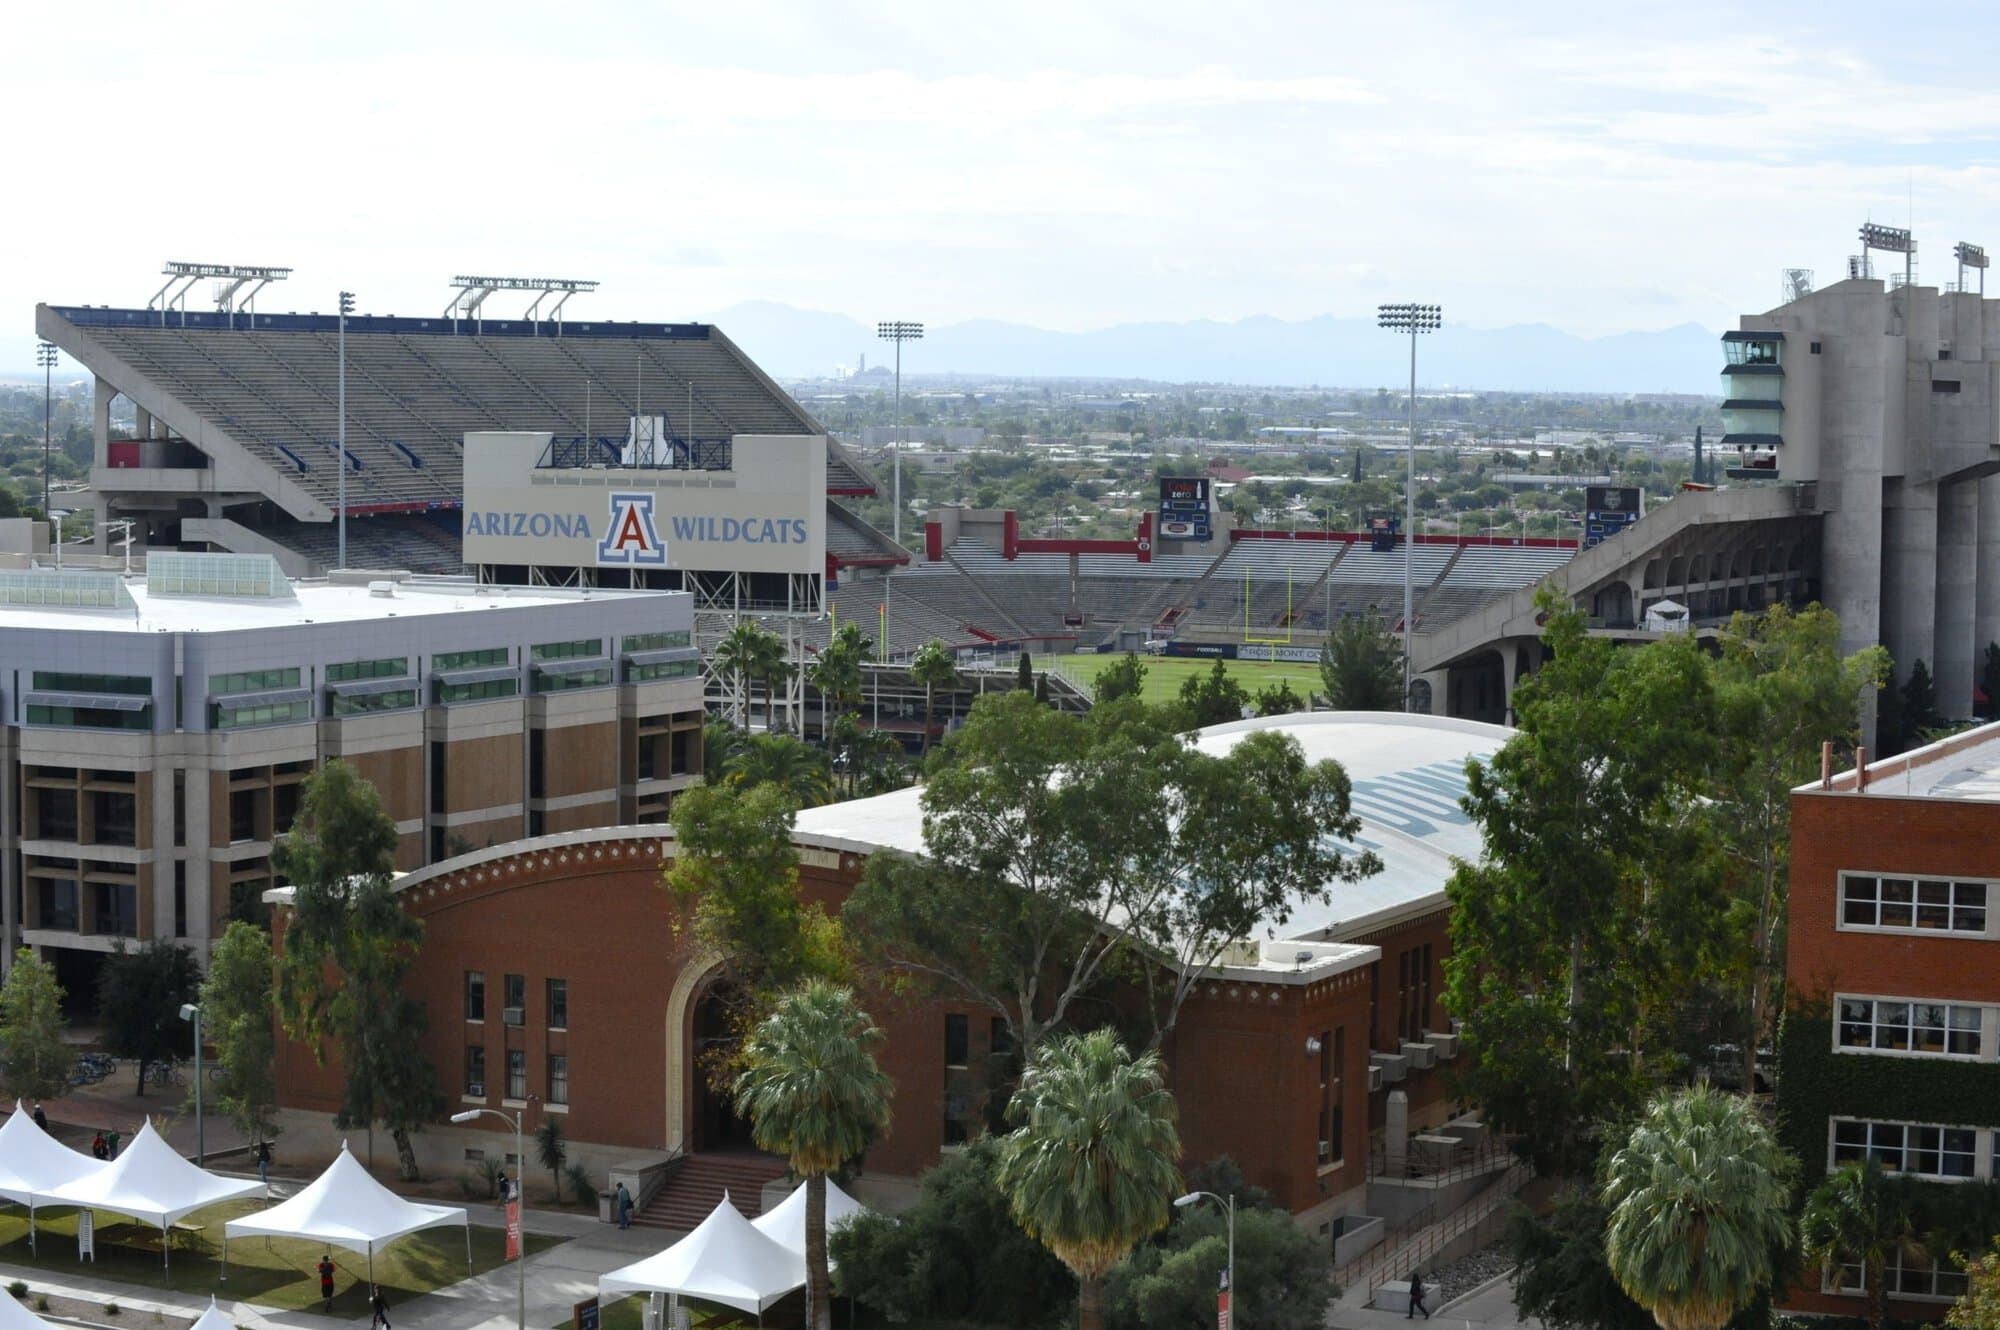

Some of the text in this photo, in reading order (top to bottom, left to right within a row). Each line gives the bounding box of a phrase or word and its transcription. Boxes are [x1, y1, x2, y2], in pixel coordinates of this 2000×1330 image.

[466, 491, 807, 566] ARIZONA A WILDCATS
